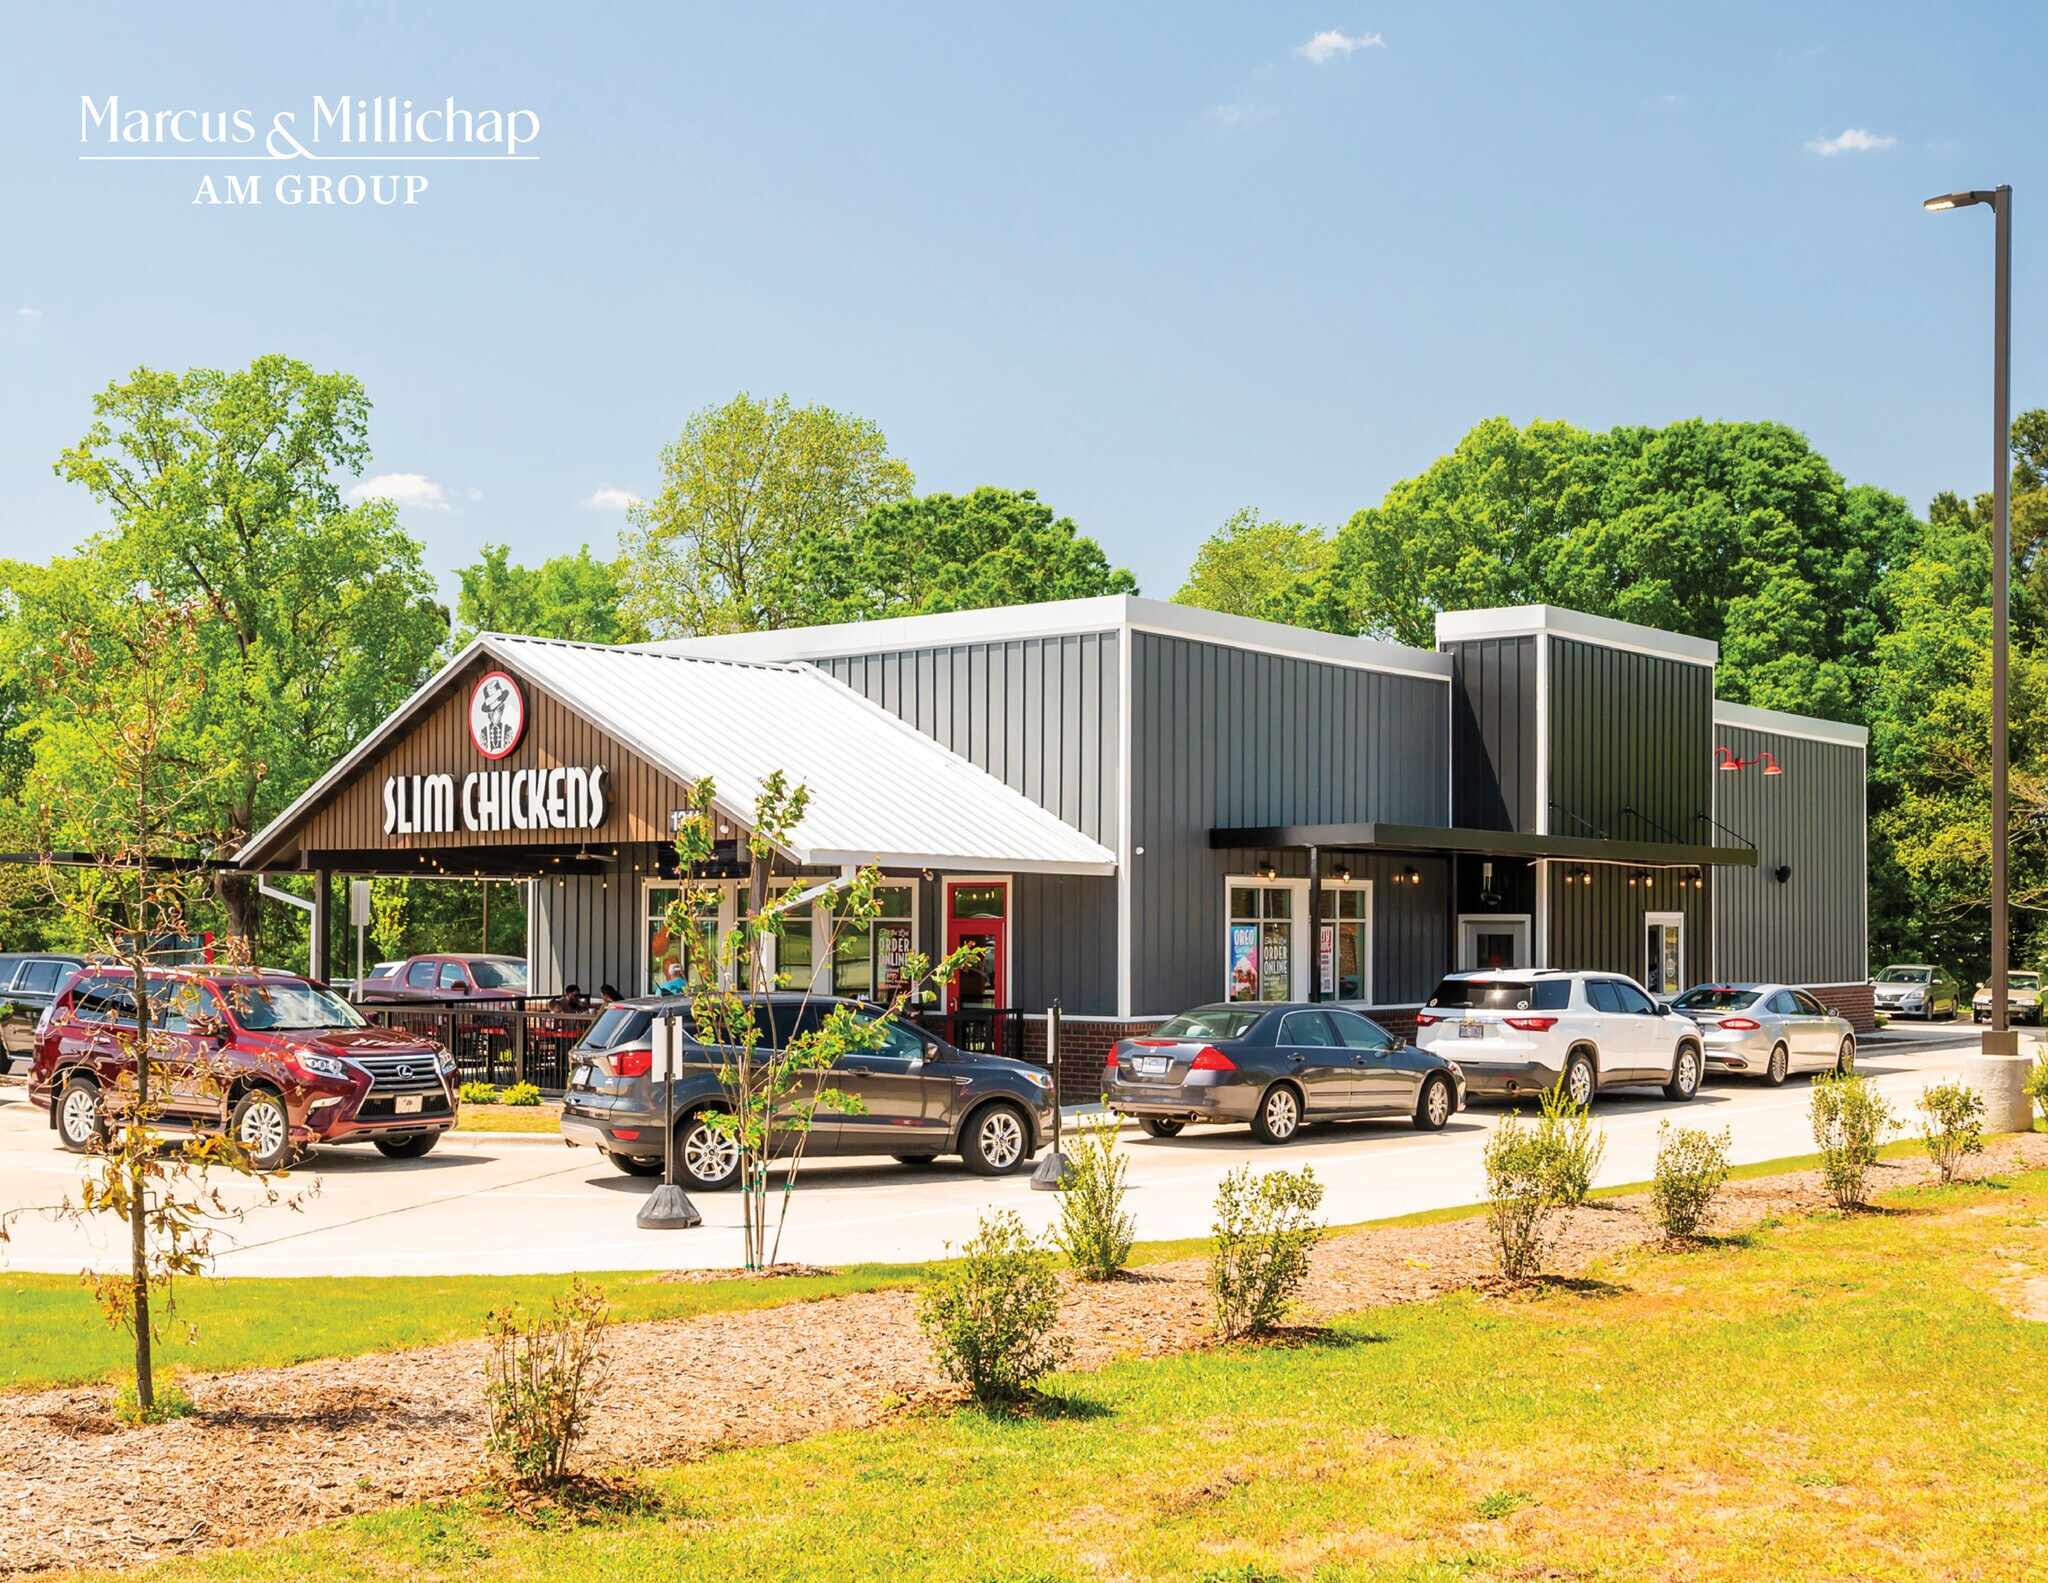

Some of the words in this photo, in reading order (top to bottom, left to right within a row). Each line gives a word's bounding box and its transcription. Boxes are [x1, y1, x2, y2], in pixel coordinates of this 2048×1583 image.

[383, 775, 456, 835] SLIM
[462, 765, 606, 832] CHICKENS
[878, 938, 910, 952] ORDER
[1234, 929, 1254, 946] OREO
[1264, 946, 1288, 960] ORDER
[1263, 960, 1288, 975] ONLINE
